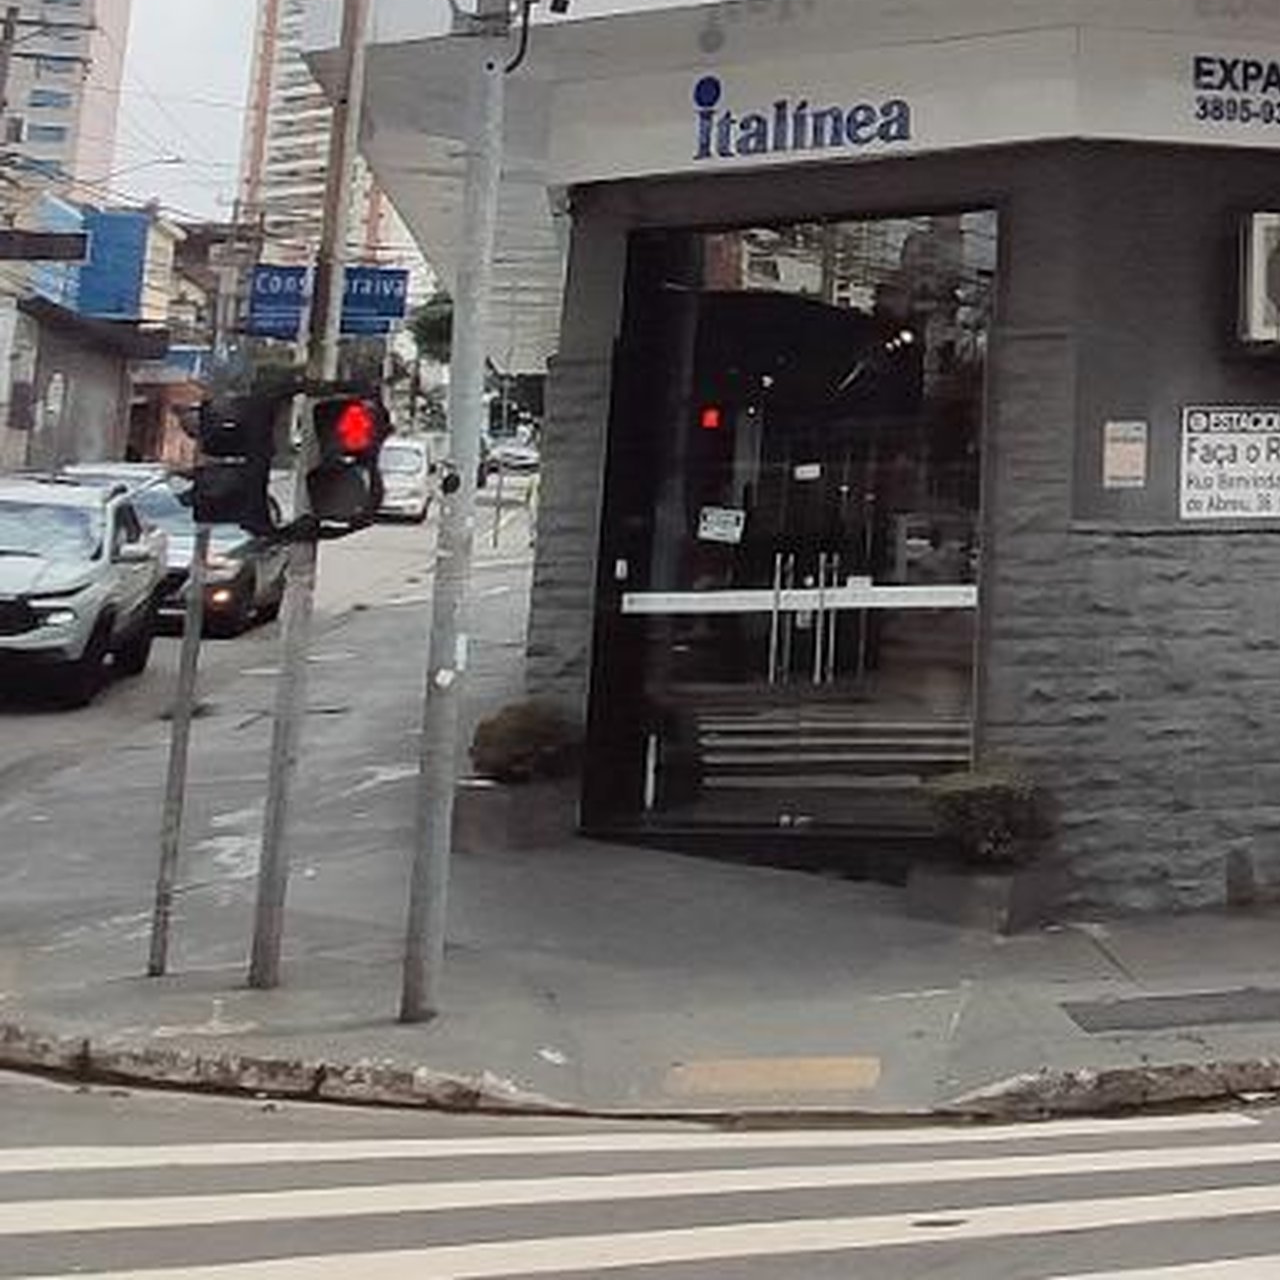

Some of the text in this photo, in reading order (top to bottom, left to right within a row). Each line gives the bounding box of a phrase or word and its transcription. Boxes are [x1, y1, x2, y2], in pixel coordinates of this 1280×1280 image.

[693, 76, 911, 160] italínea
[1187, 436, 1238, 469] Faça
[1246, 444, 1261, 464] o
